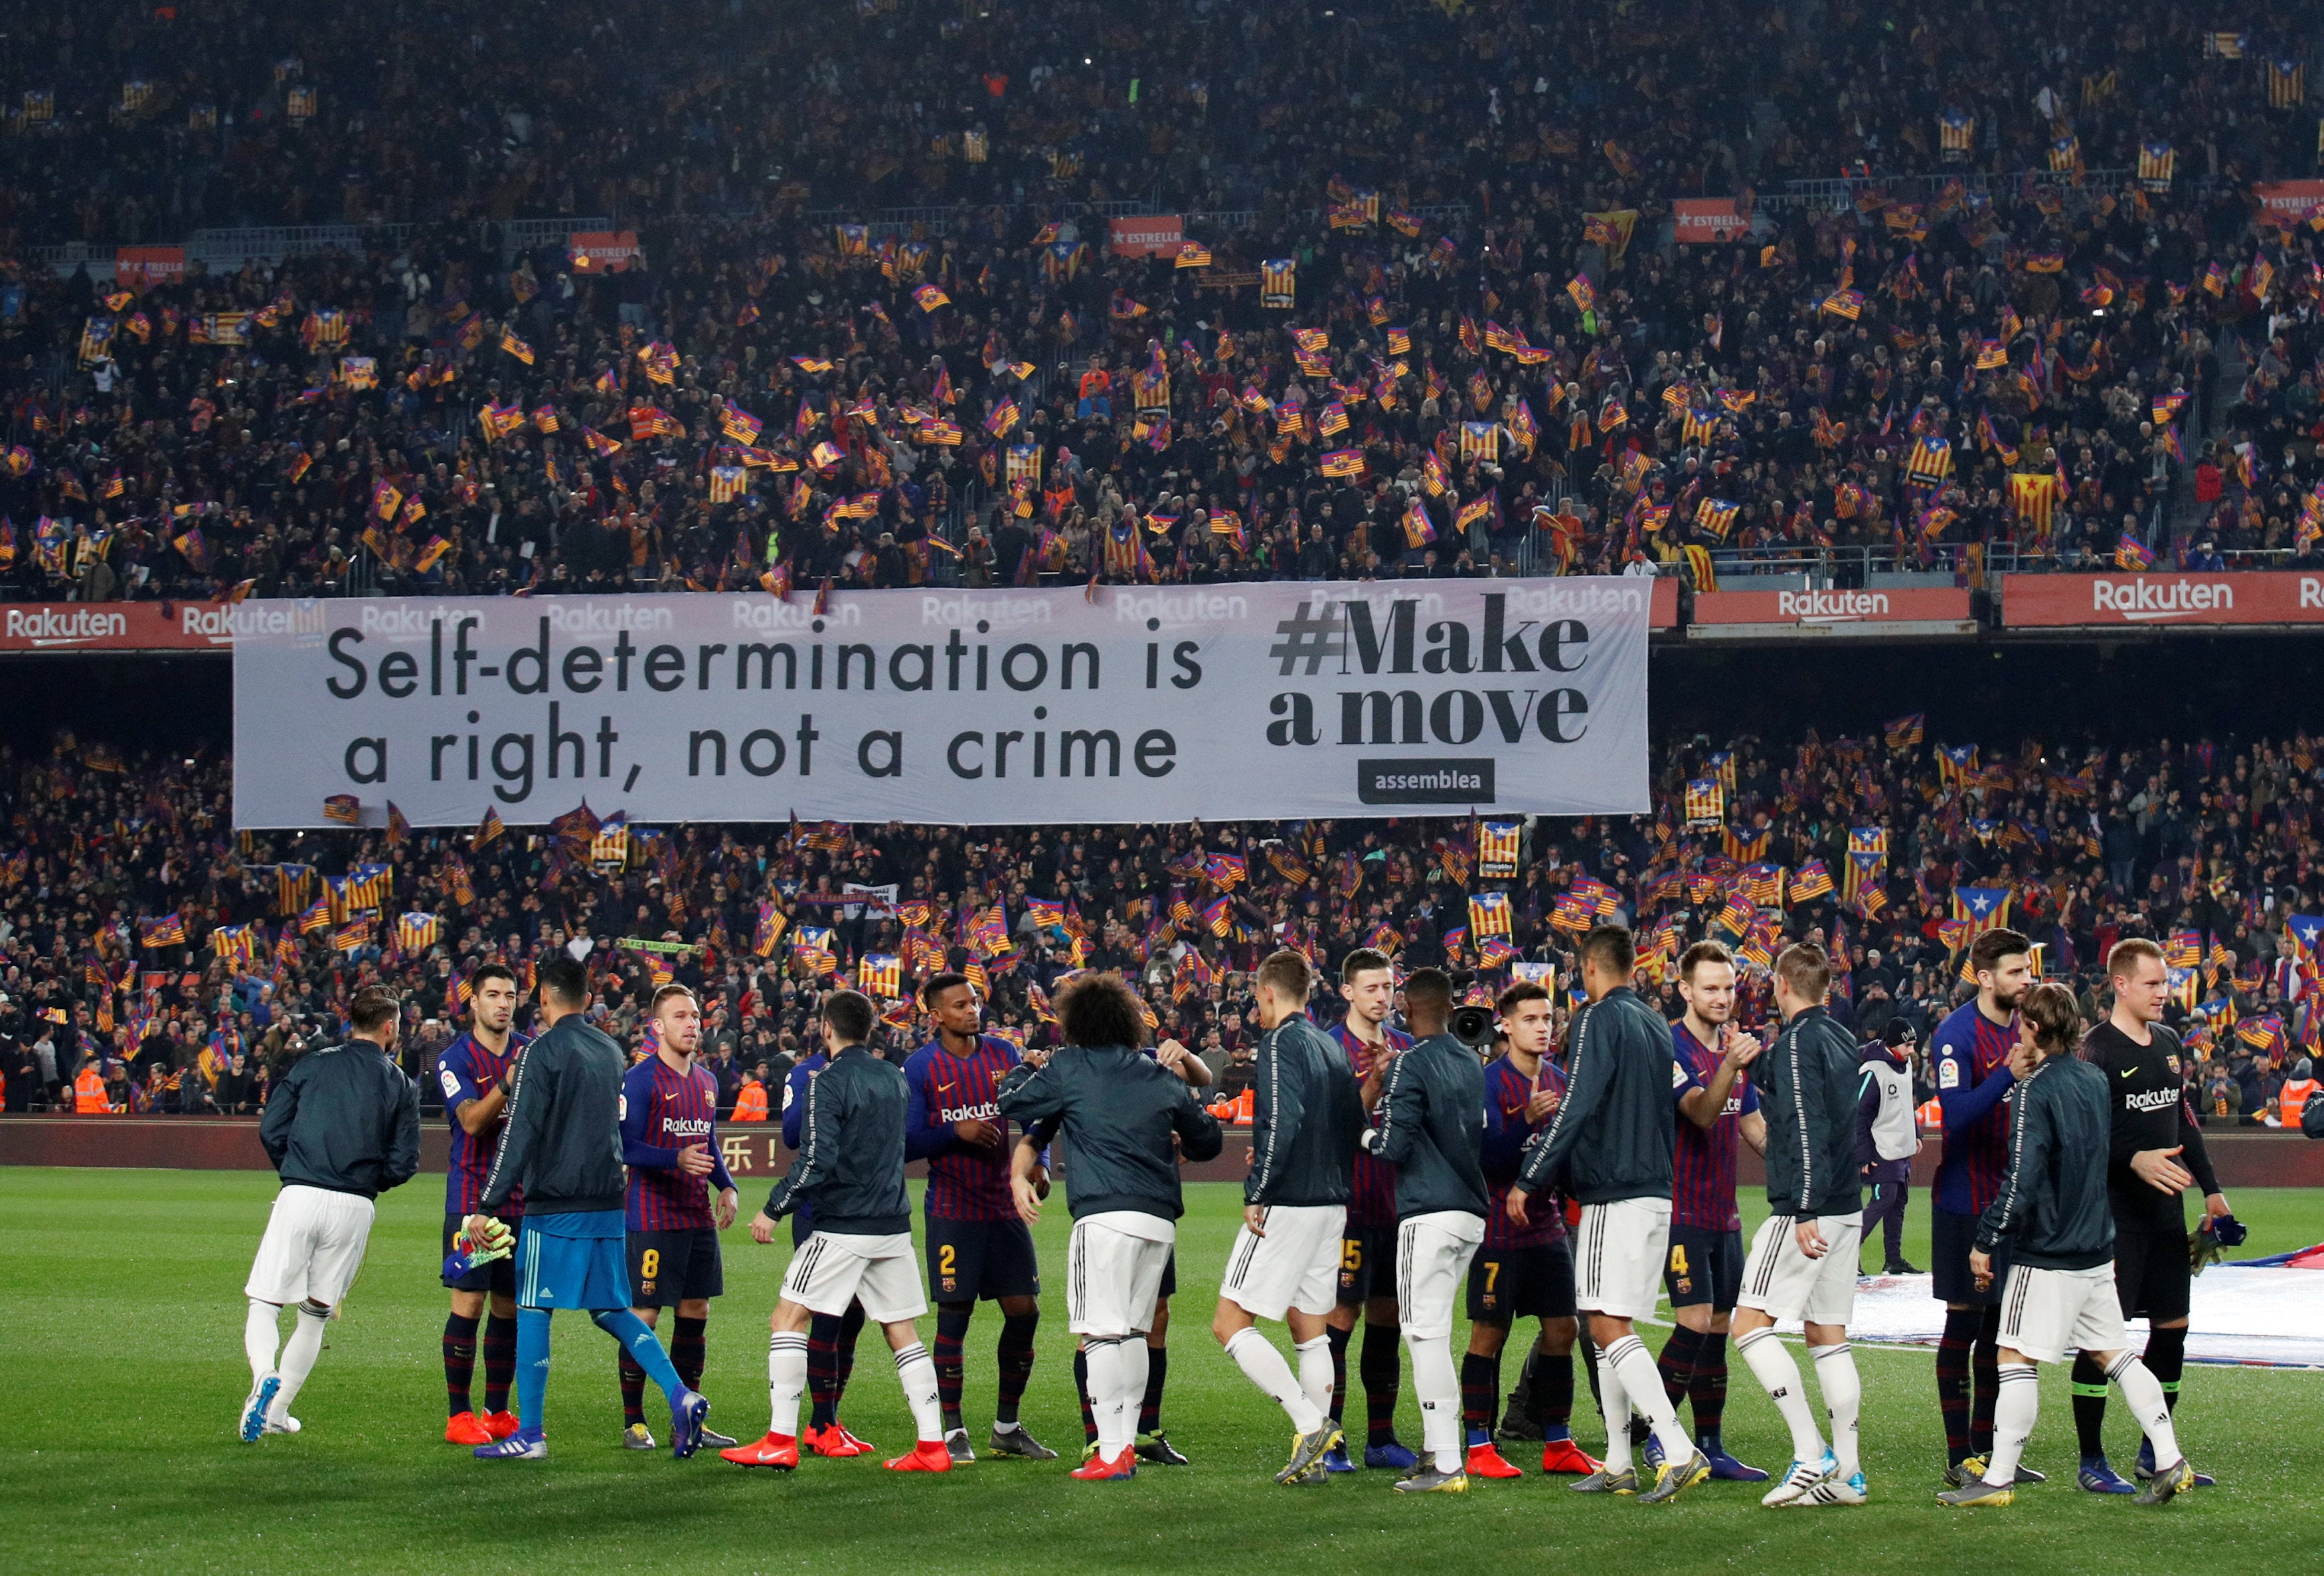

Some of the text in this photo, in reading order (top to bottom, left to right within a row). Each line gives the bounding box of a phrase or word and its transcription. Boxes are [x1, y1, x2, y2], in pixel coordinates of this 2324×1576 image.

[1127, 232, 1182, 244] ESTRELLA
[1116, 592, 1248, 622] Rakuten
[1507, 585, 1642, 615] Rakuten
[1779, 590, 1889, 616] Rakuten
[2094, 578, 2233, 610] Rakuten
[7, 607, 126, 638] Rakuten
[548, 602, 673, 632] Rakuten
[922, 596, 1051, 625] Rakuten
[1269, 593, 1589, 675] #Make
[325, 616, 1202, 700] Self-determination is
[1266, 687, 1588, 746] a move
[344, 700, 1177, 804] a right, not a crime
[1375, 770, 1481, 789] assemblea
[941, 1100, 1001, 1123] Rakute
[641, 1248, 659, 1279] 8
[940, 1244, 956, 1275] 2
[1670, 1244, 1689, 1275] 4
[1483, 1262, 1500, 1292] 7
